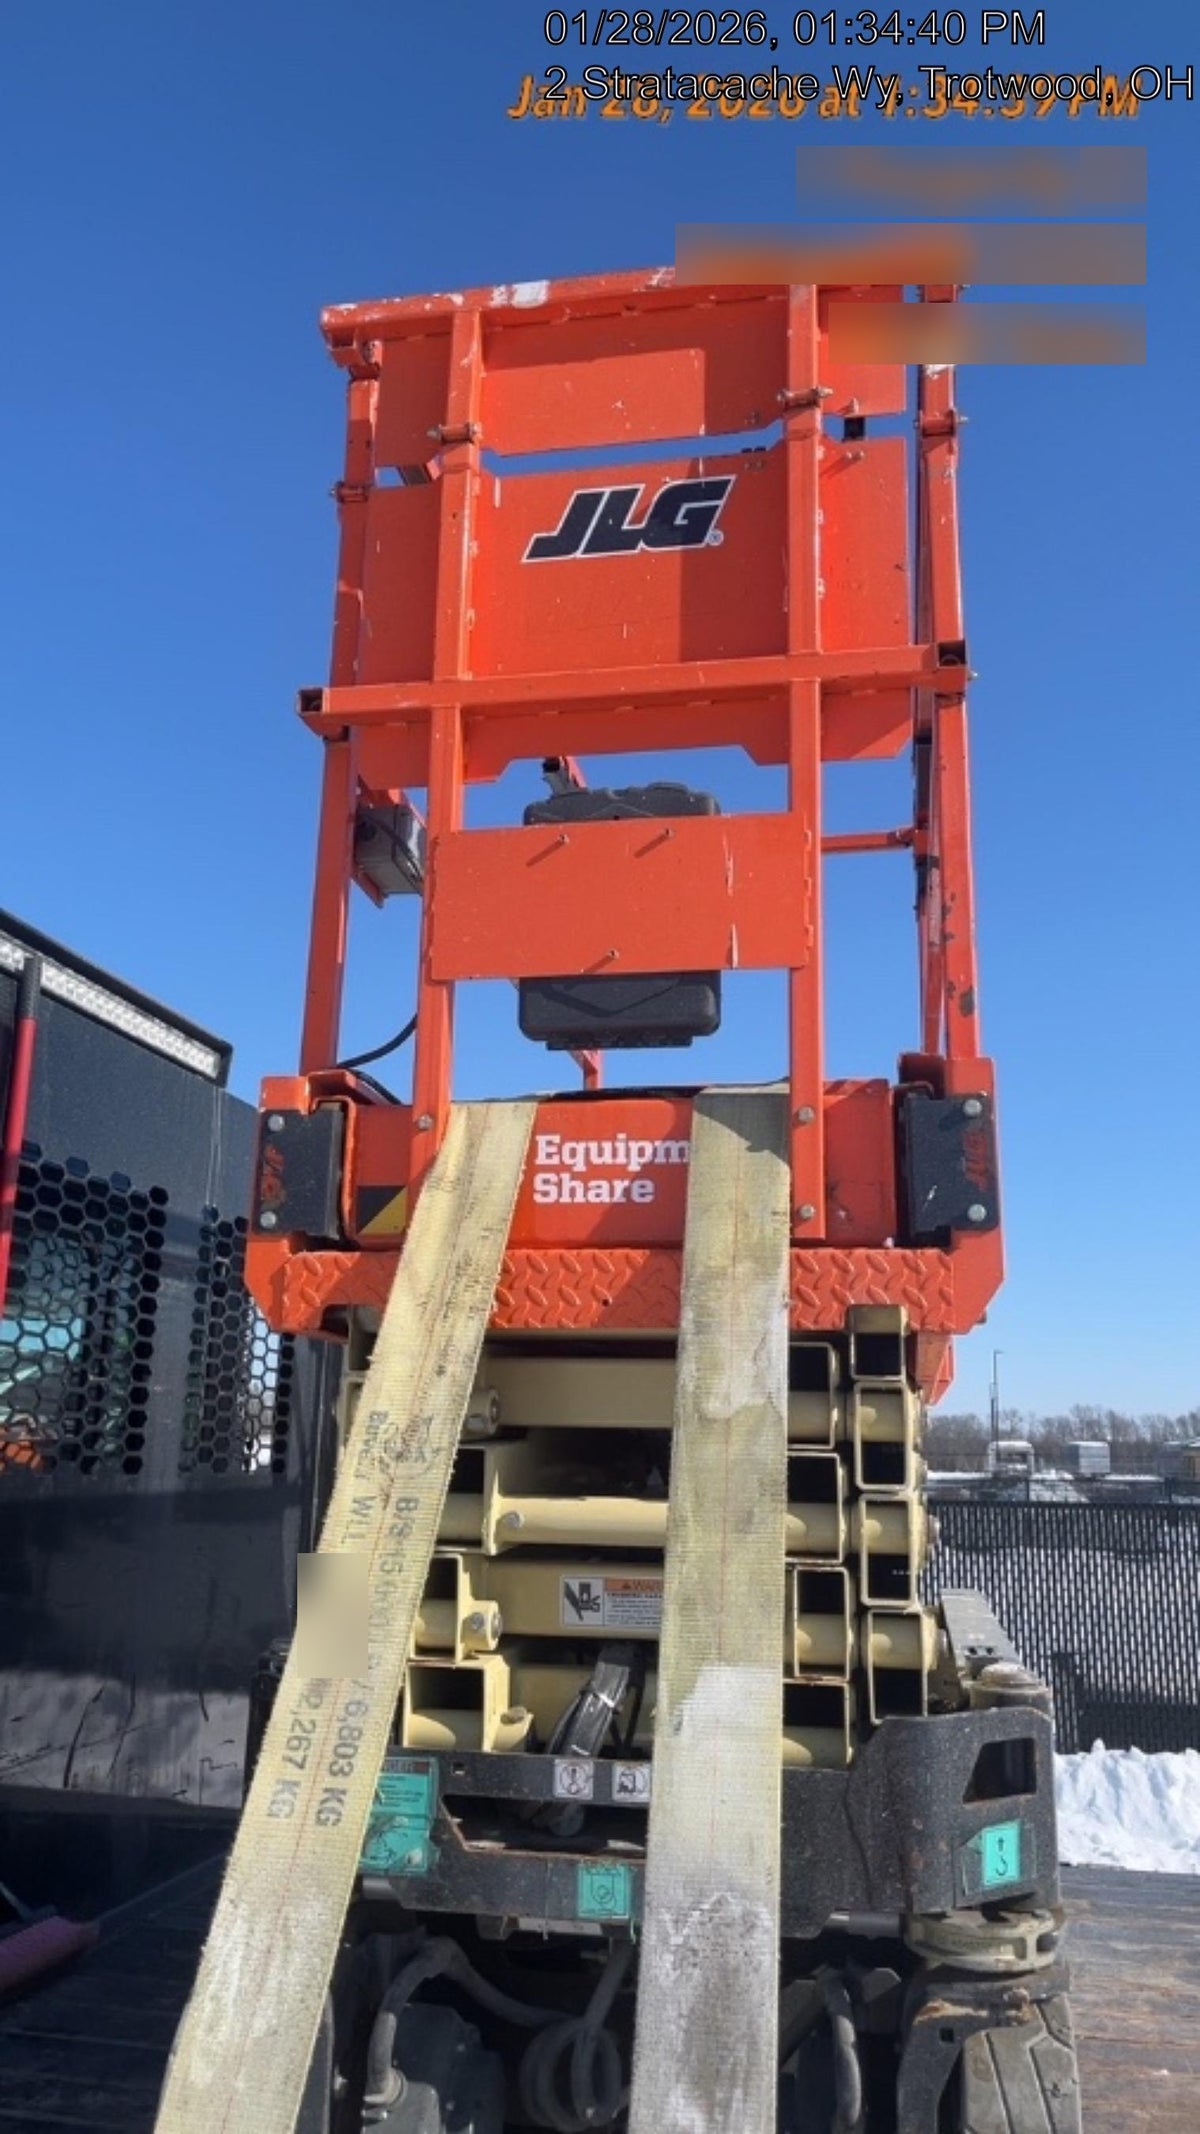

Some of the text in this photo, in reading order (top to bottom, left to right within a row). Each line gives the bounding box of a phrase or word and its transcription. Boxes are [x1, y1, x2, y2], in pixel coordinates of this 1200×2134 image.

[521, 475, 737, 563] JLG
[533, 1173, 656, 1204] Share
[328, 1700, 369, 1778] 6,803
[267, 1777, 301, 1820] KG
[314, 1786, 348, 1827] KG
